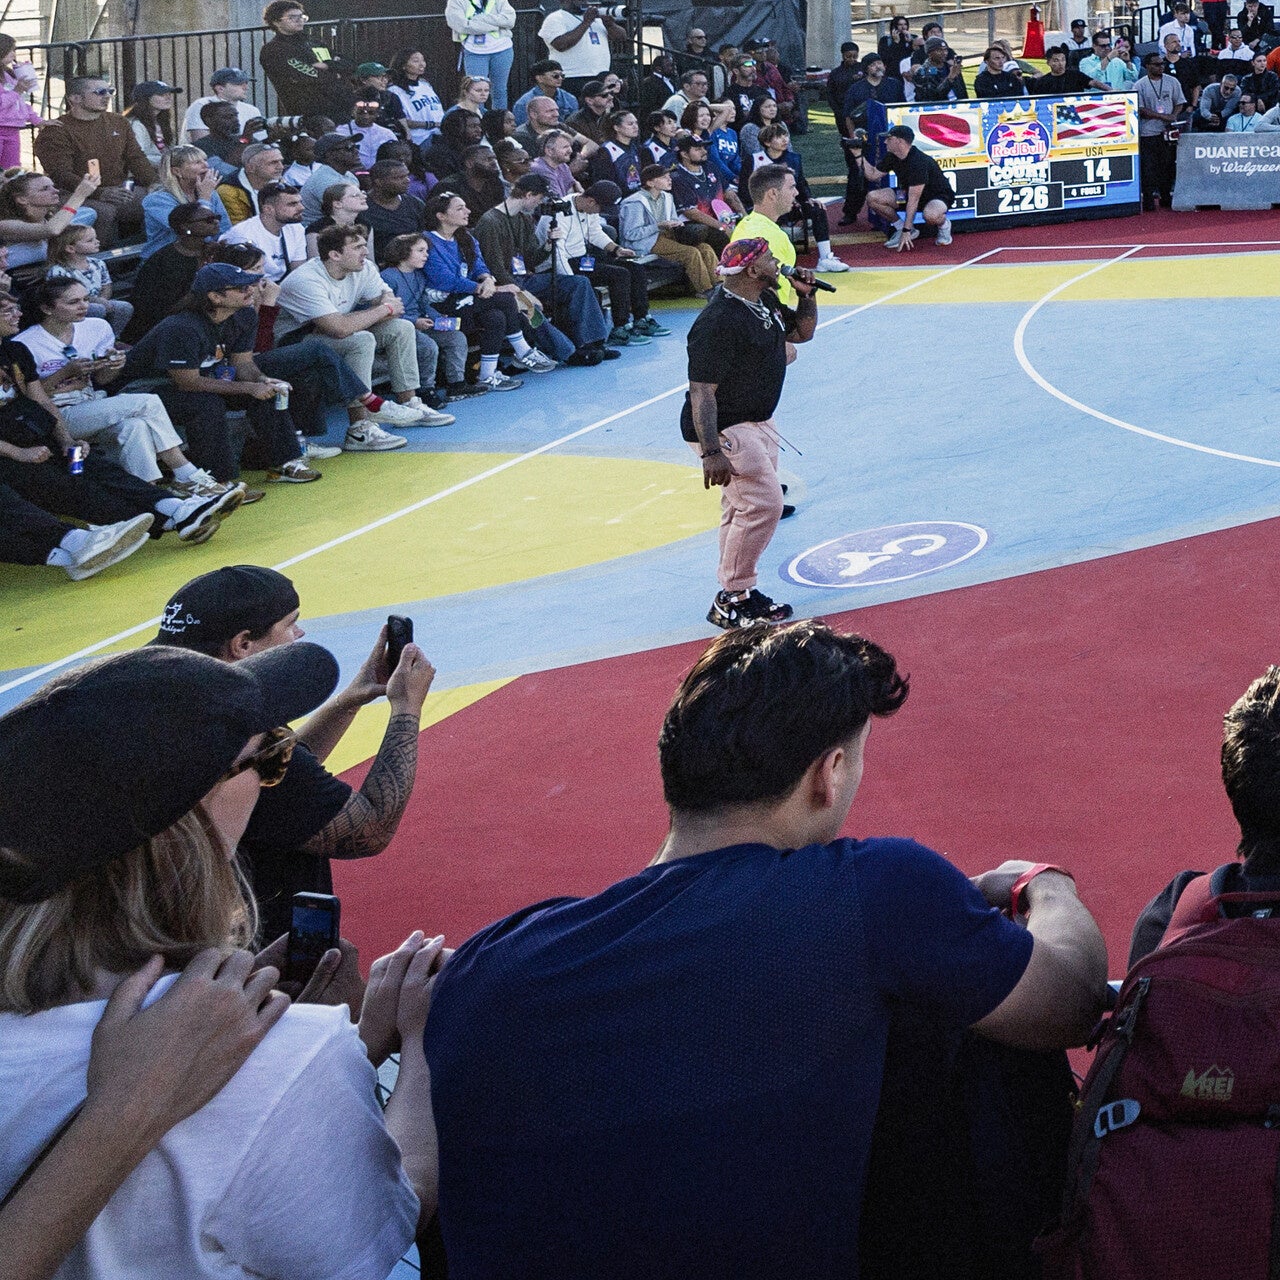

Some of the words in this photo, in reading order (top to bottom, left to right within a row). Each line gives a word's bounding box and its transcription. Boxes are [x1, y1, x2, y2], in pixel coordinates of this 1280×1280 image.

[993, 143, 1019, 157] Red
[1020, 141, 1045, 154] Bull
[1085, 145, 1104, 157] USA
[990, 161, 1048, 183] COURT
[1083, 158, 1111, 184] 14
[1210, 164, 1221, 175] by
[998, 186, 1049, 213] 2:26
[1080, 186, 1102, 197] FOULS
